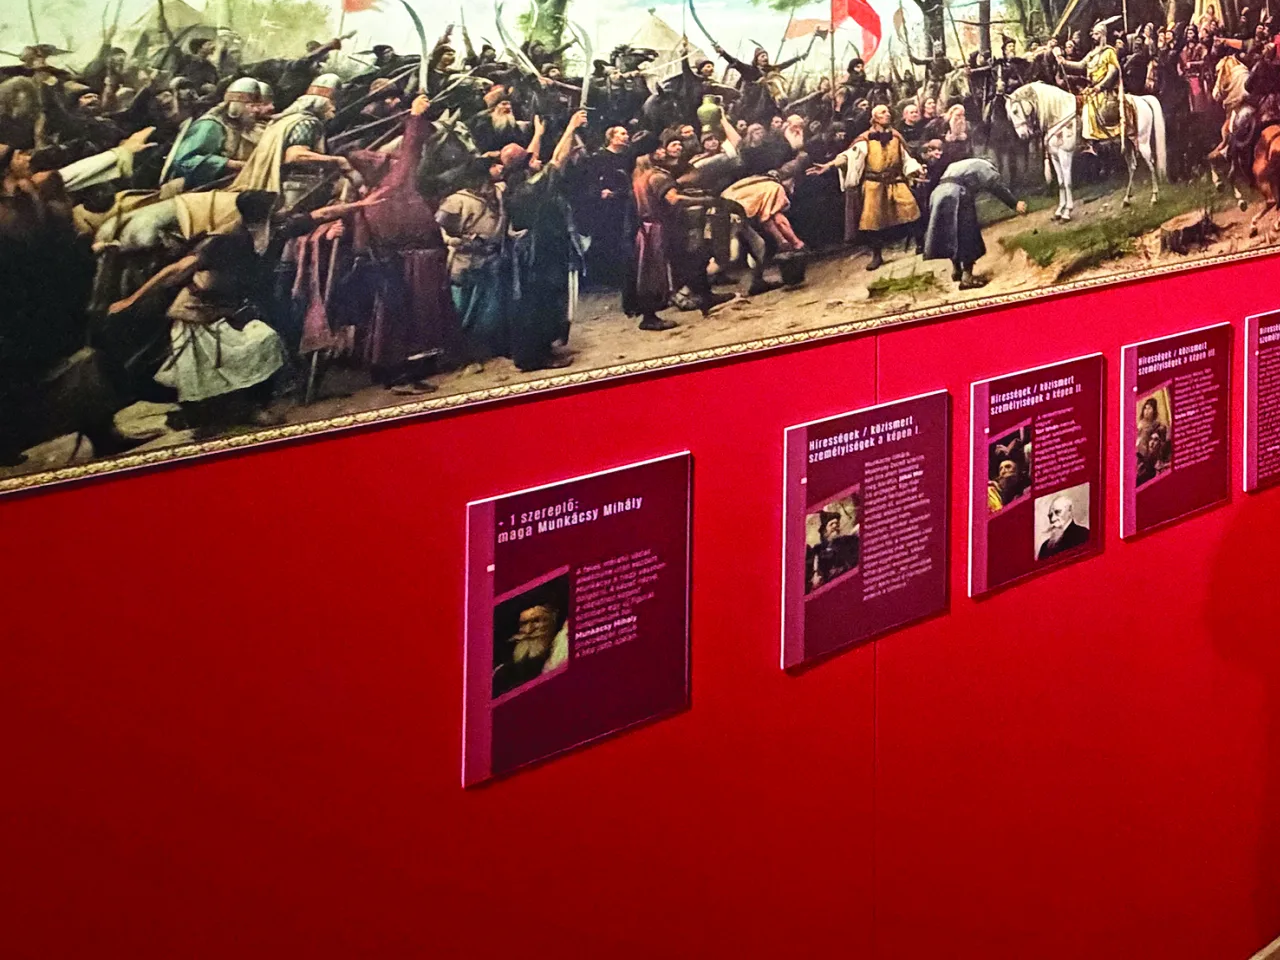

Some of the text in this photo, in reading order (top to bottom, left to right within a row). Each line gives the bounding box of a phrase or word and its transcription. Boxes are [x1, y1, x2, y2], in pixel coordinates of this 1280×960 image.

[1183, 356, 1187, 364] a
[991, 375, 1074, 404] Hírességek / közismert
[991, 393, 1043, 415] személyiségek
[1046, 392, 1050, 400] a
[1053, 386, 1073, 398] képen
[809, 416, 913, 451] Hírességek / közismert
[809, 437, 875, 463] személyiségek
[878, 436, 882, 444] a
[887, 428, 912, 441] képen
[498, 497, 642, 543] maga Munkácsy Mihály
[511, 514, 514, 525] 1
[521, 498, 579, 523] szereplő:
